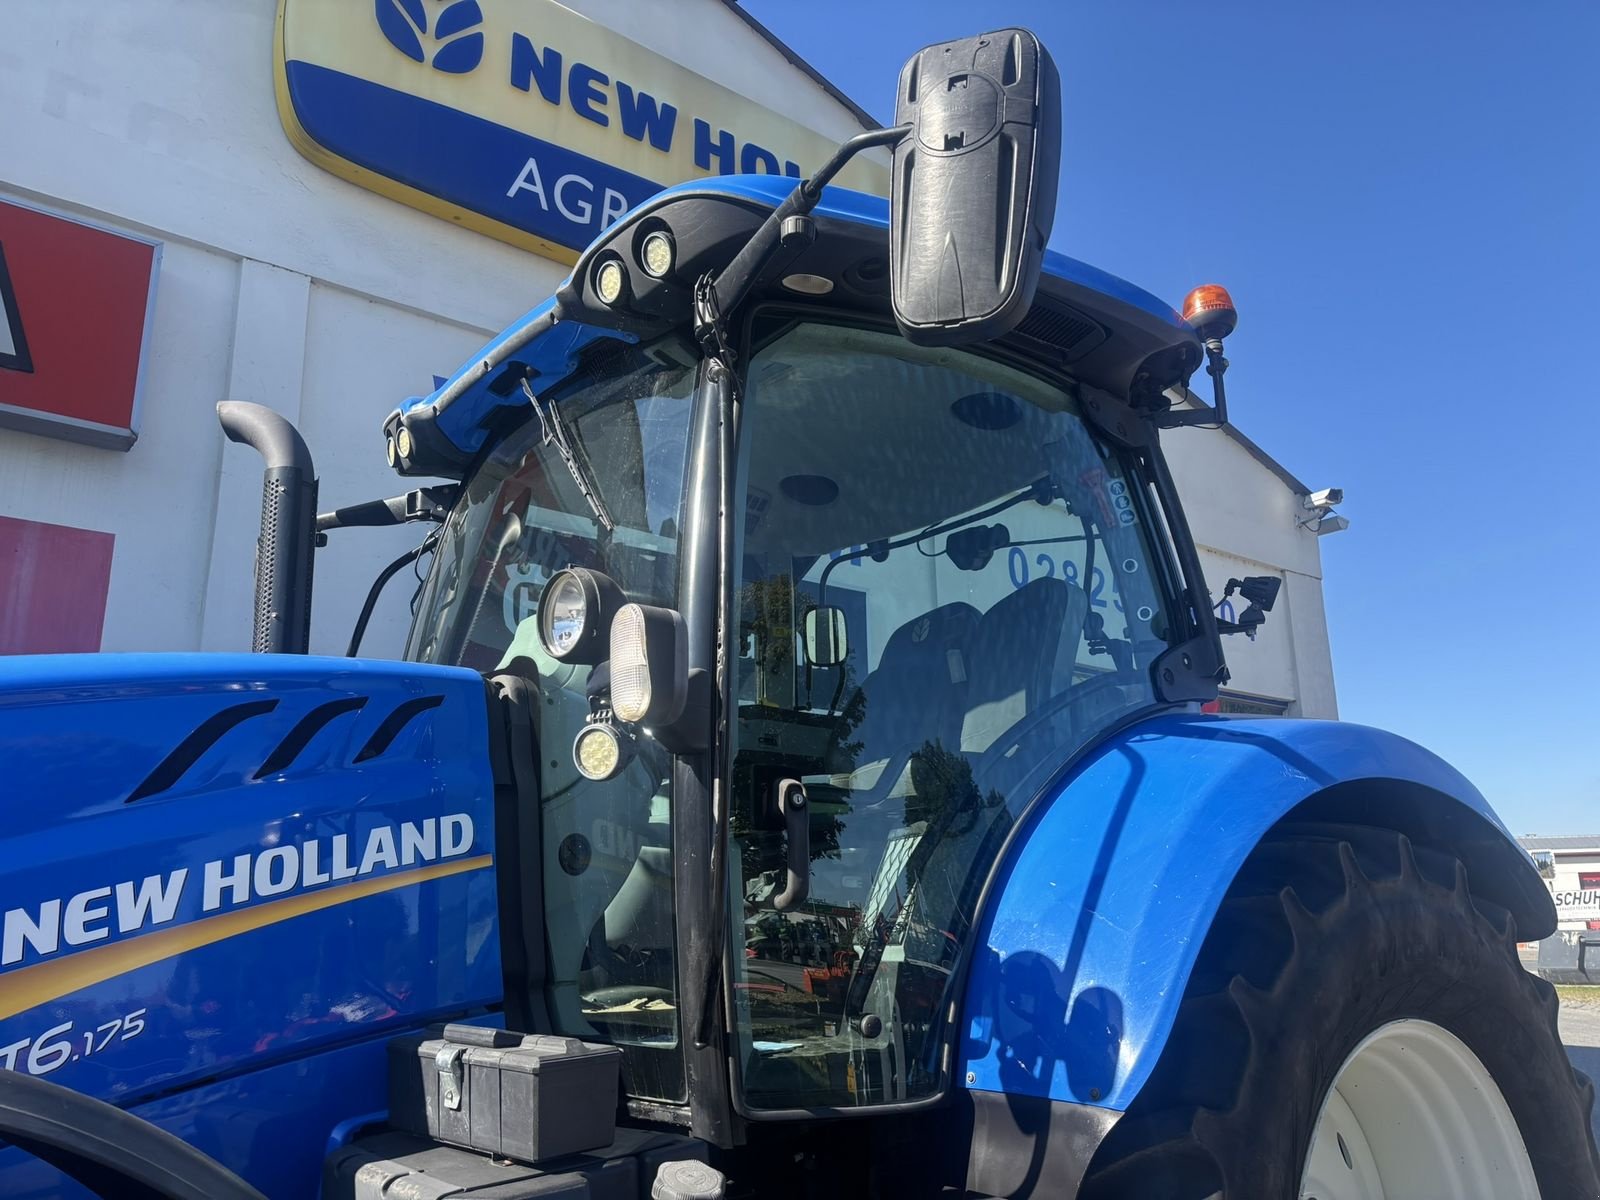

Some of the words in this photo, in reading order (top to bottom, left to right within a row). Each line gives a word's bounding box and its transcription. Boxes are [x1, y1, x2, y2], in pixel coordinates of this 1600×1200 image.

[511, 32, 677, 152] NEW
[1, 868, 188, 966] NEW
[203, 812, 475, 911] HOLLAND
